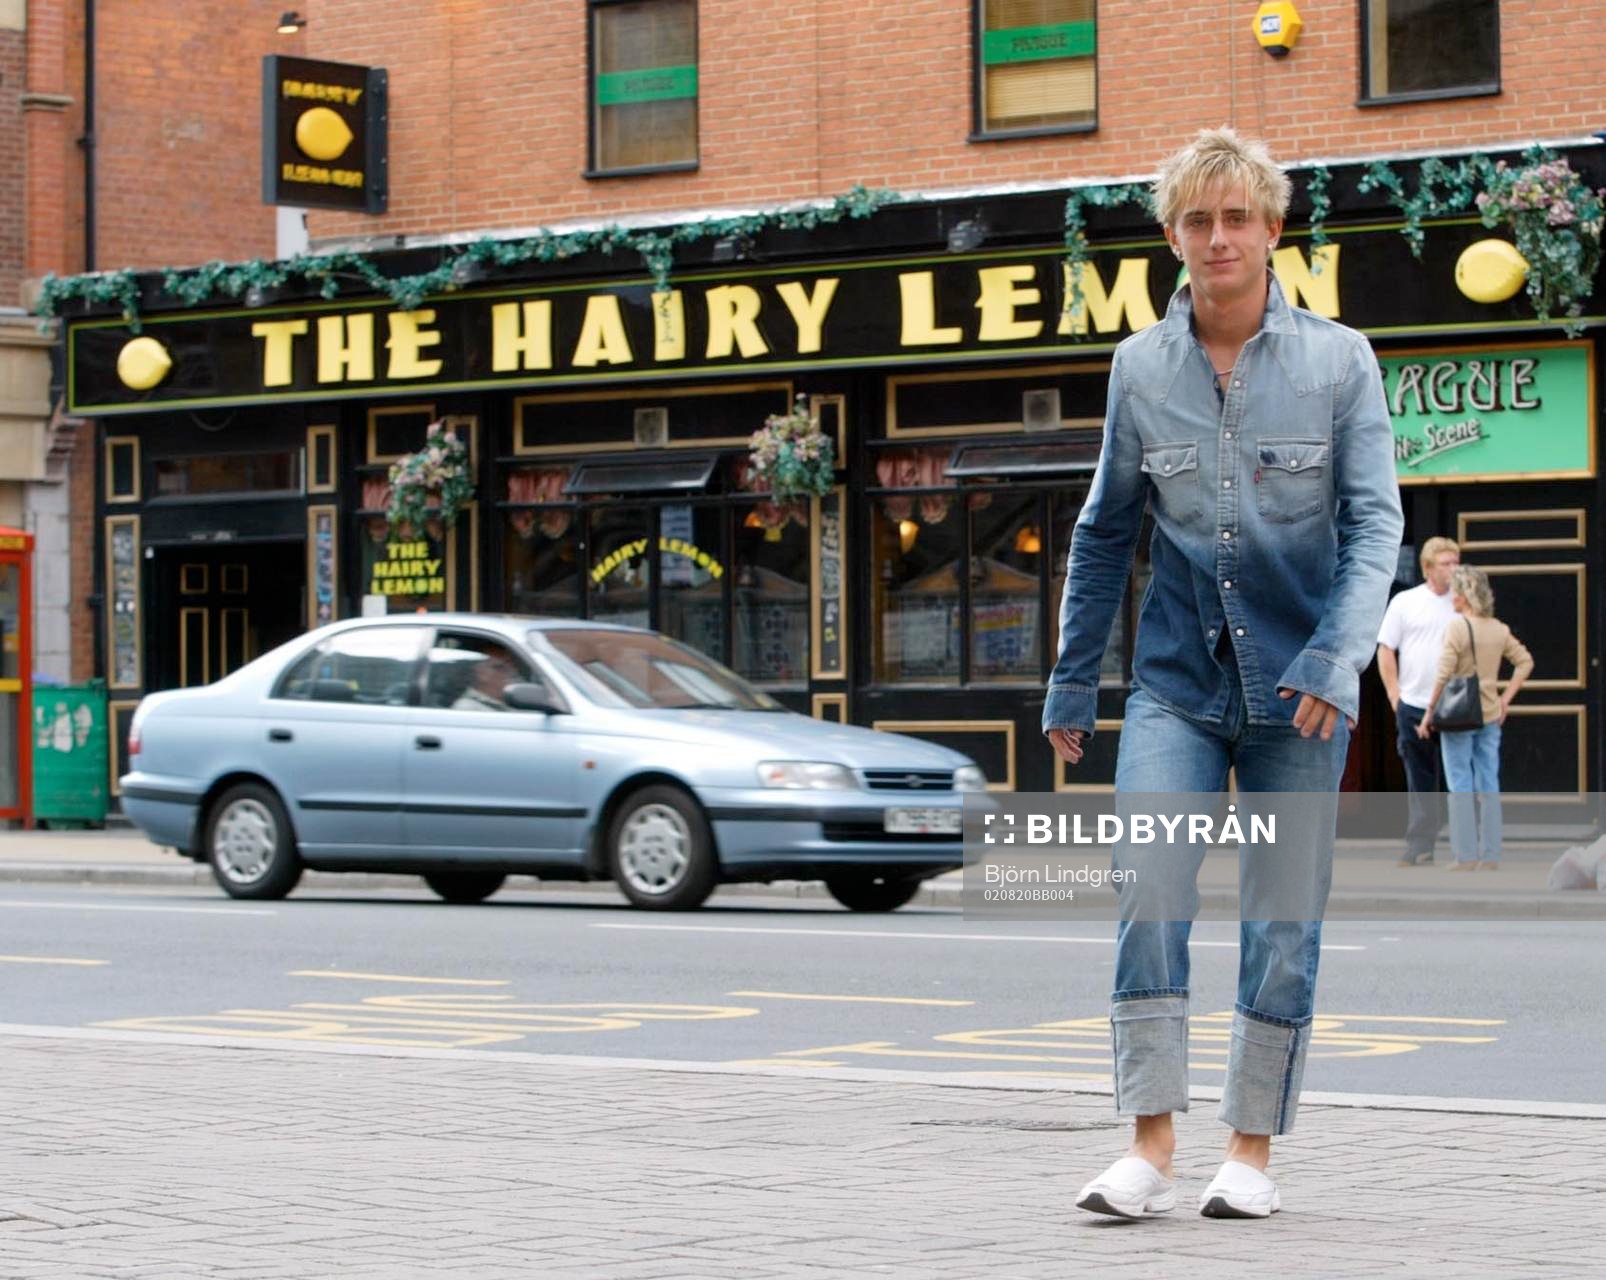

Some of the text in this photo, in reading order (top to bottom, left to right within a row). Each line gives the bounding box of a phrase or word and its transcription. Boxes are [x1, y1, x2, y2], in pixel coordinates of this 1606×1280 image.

[251, 243, 1341, 387] THE HAIRY LEMN
[1381, 358, 1542, 417] AGUE
[1423, 419, 1482, 451] Scene
[386, 541, 429, 559] THE
[591, 536, 723, 582] HAIRY LEMON
[373, 559, 442, 577] HAIRY
[371, 577, 445, 595] LEMON
